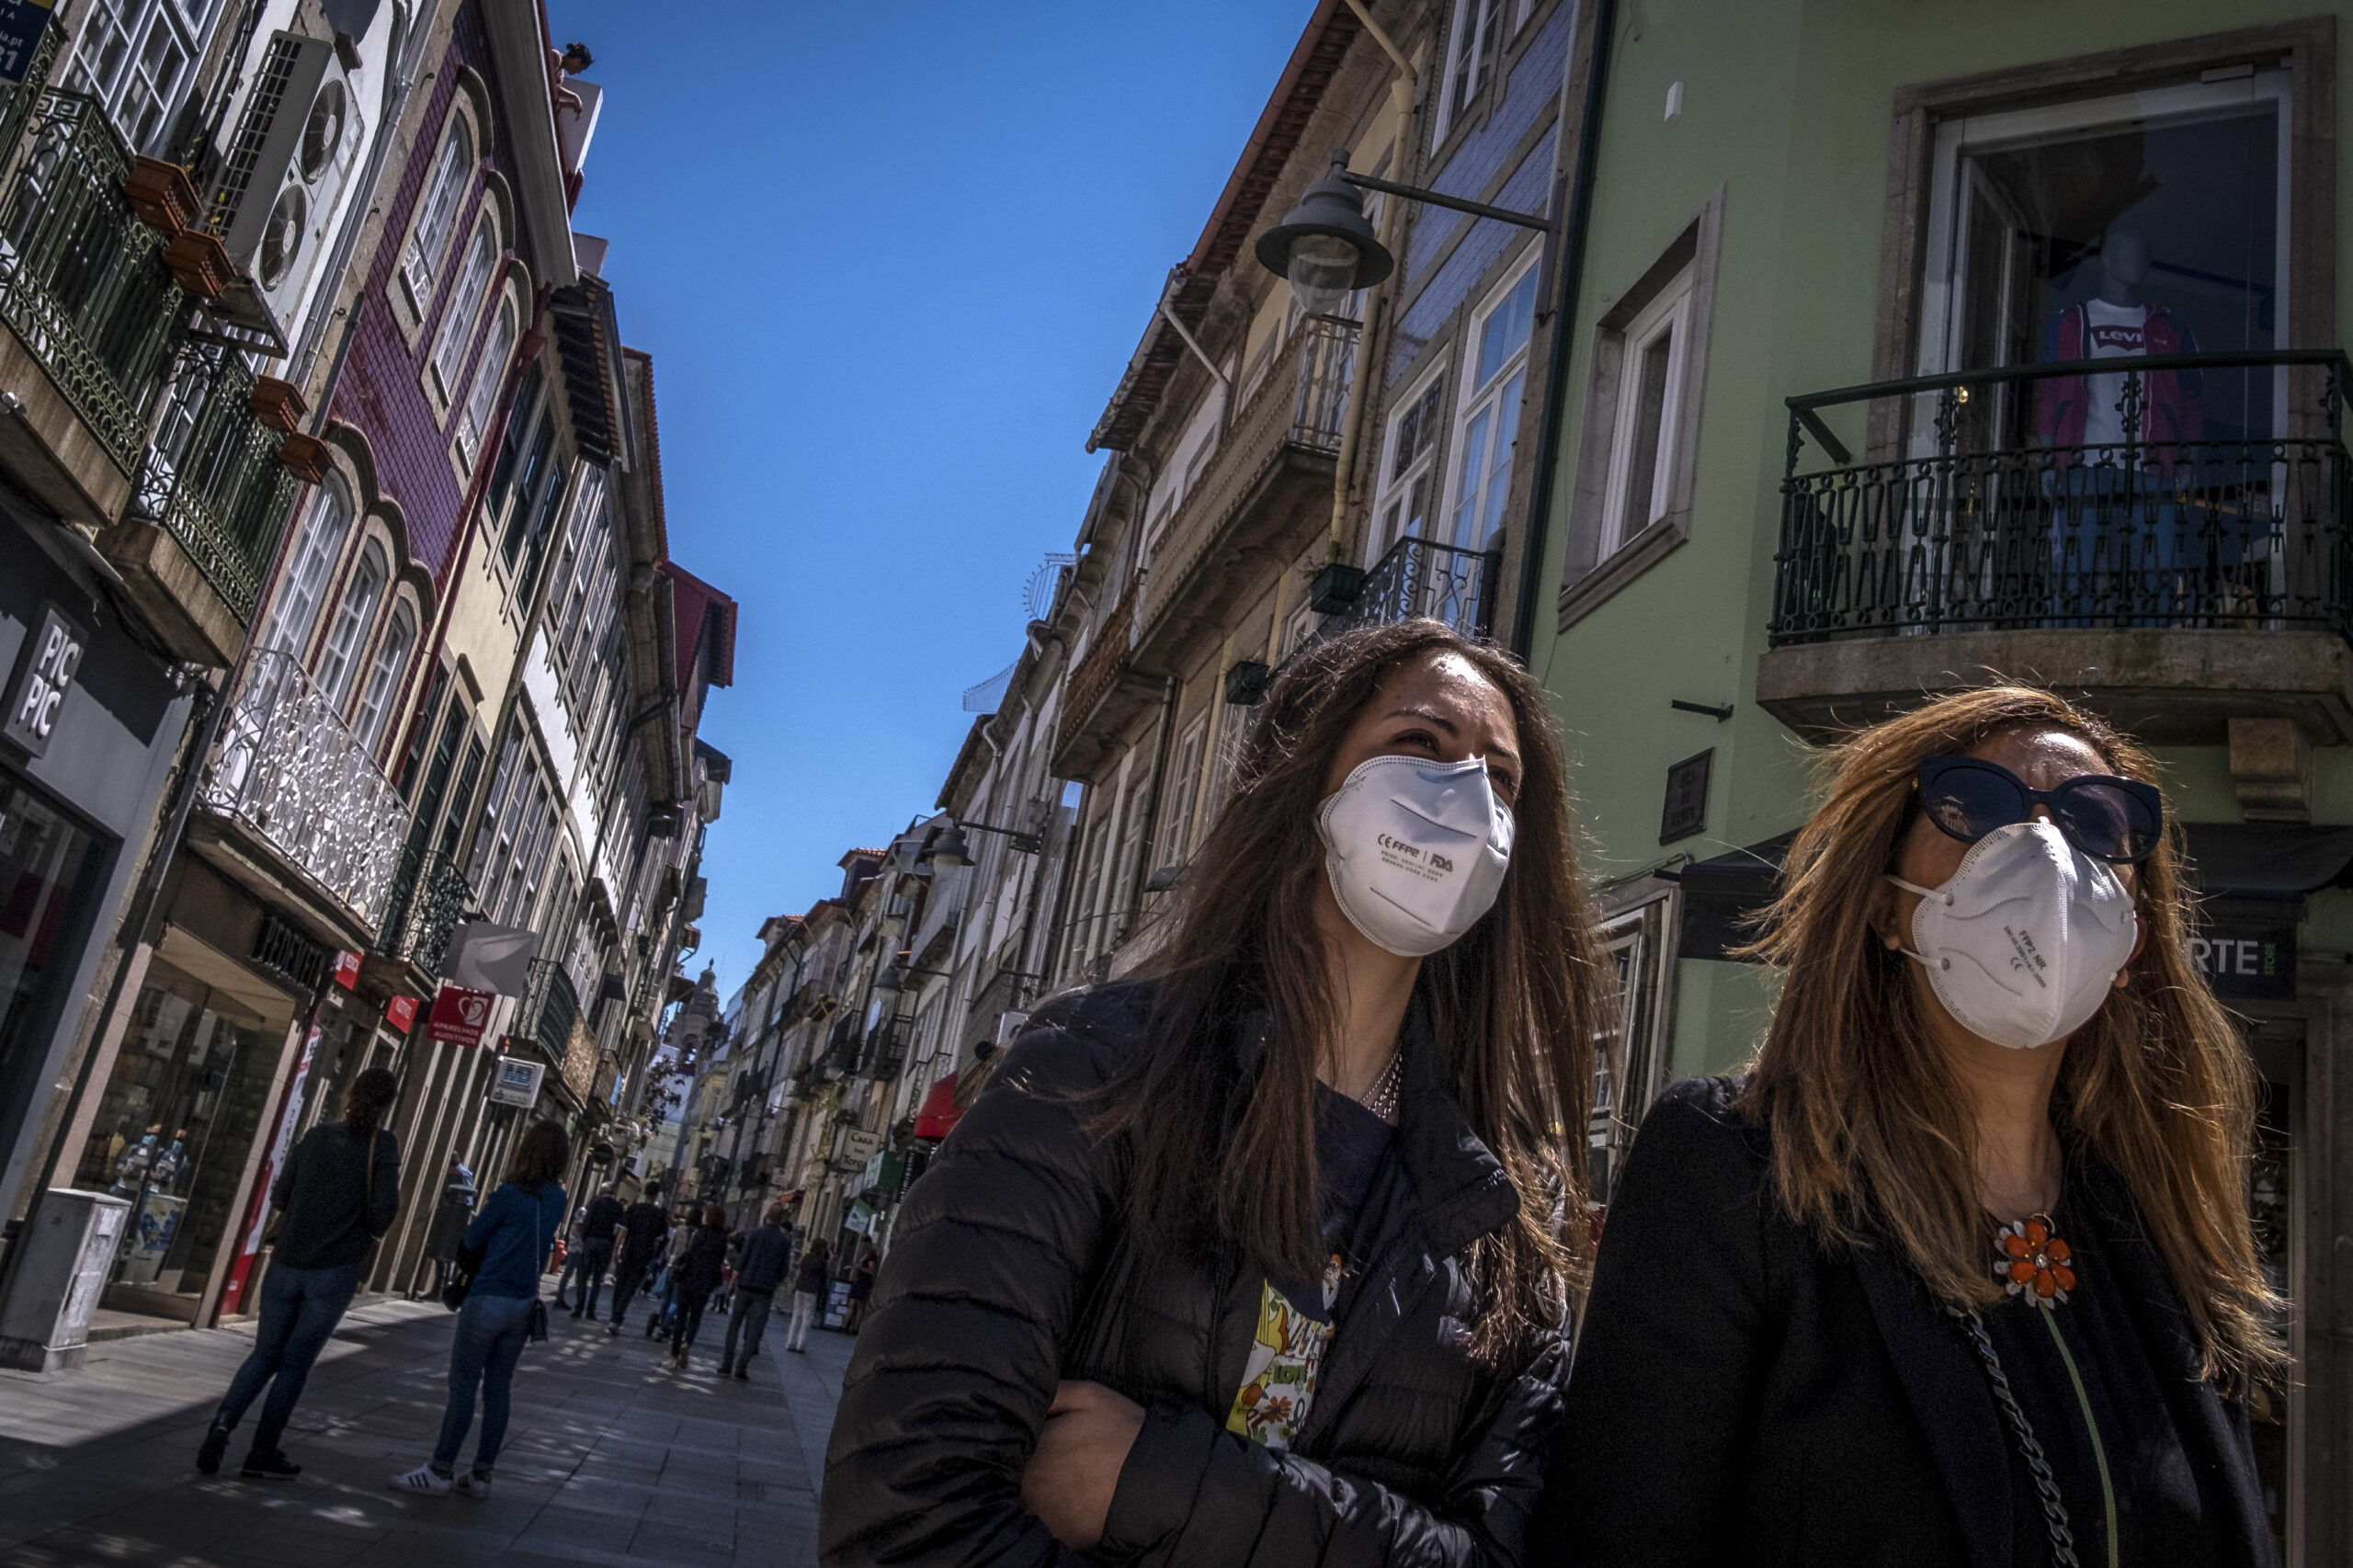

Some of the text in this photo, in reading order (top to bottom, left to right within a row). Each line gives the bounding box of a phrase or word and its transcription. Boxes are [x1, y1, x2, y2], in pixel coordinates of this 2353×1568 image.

[2098, 330, 2143, 343] Levi
[38, 625, 79, 687] PIC
[20, 675, 62, 737] PIC
[1392, 841, 1420, 858] FFP2
[1430, 853, 1453, 872] FDA
[2018, 929, 2047, 971] FFP2 NR
[2187, 937, 2276, 976] RTE STORE
[433, 1022, 479, 1036] APARELHOS
[433, 1031, 477, 1045] AUDITIVOS
[1273, 1365, 1307, 1384] LOVE
